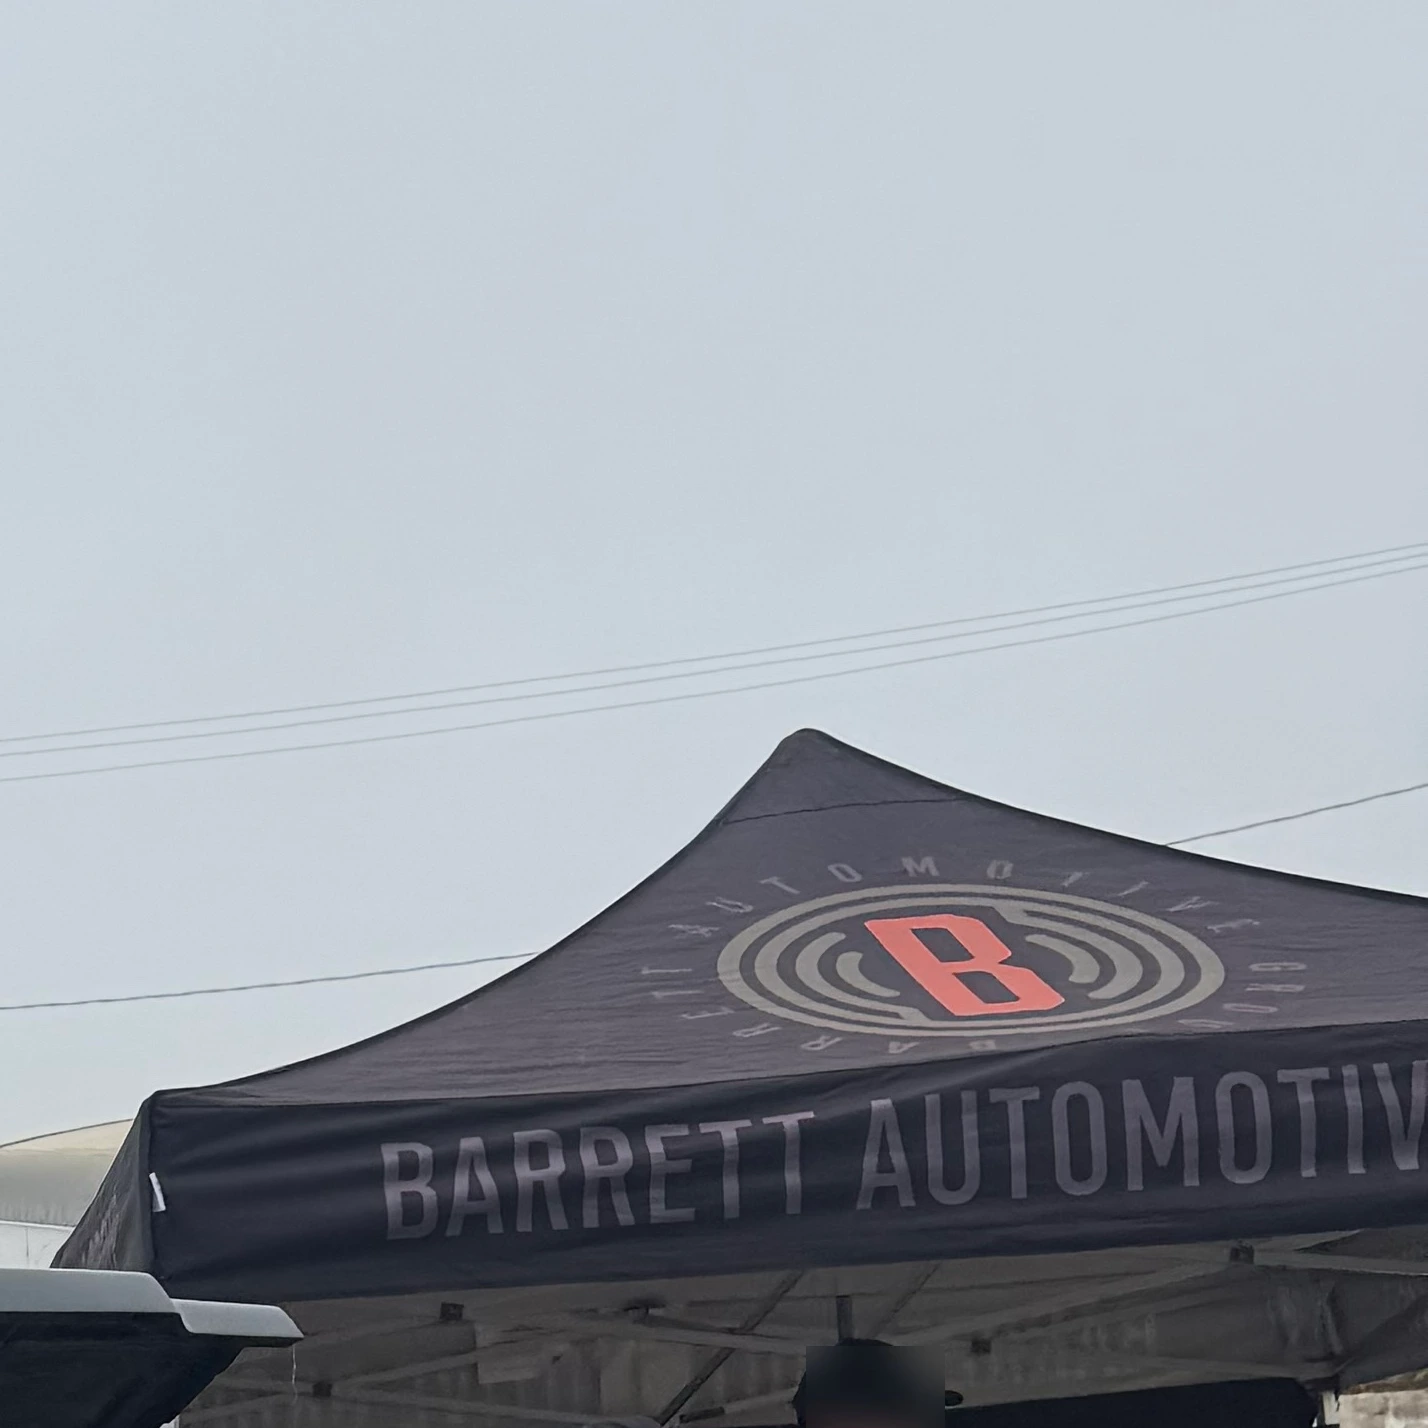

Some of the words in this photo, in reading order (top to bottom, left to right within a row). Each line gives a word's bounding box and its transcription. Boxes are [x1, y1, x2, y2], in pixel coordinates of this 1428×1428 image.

[864, 913, 1066, 1017] B
[380, 1110, 816, 1241] BARRETT
[855, 1059, 1428, 1212] AUTOMOTIV
